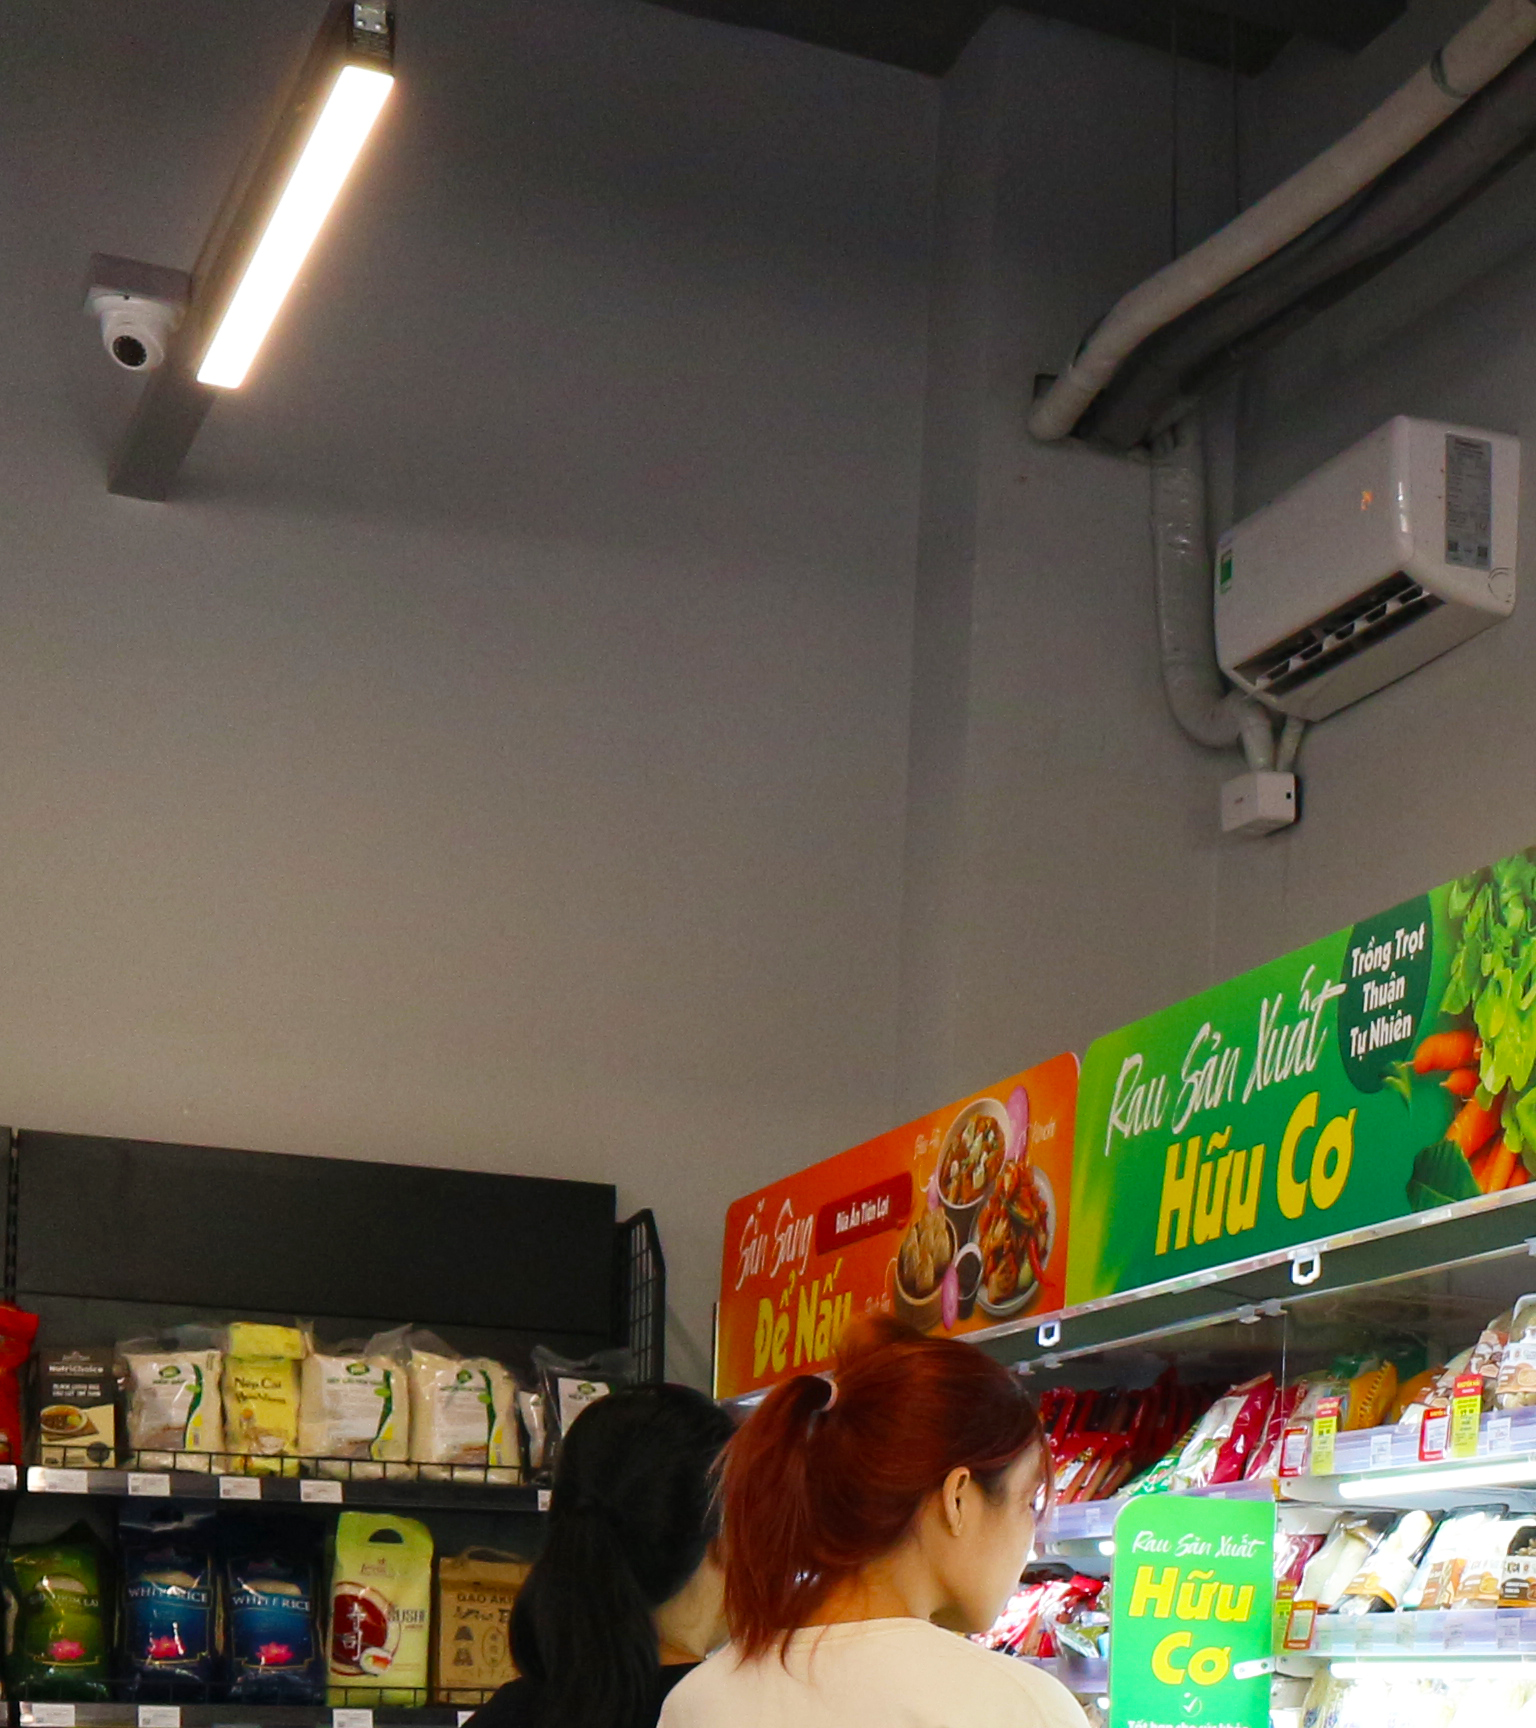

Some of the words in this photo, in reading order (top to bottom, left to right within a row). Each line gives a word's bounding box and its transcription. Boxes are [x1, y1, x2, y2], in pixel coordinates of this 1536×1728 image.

[1351, 936, 1391, 978] Trồng
[1395, 921, 1425, 961] Trọt
[1362, 973, 1405, 1013] Thuận
[1104, 1054, 1169, 1157] Rau
[1172, 1021, 1241, 1135] Sản
[1242, 964, 1346, 1105] Xuất
[1350, 1026, 1368, 1061] Tự
[1369, 1010, 1412, 1048] Nhiên
[1154, 1125, 1266, 1256] Hữu
[1276, 1090, 1358, 1220] Cơ
[1132, 1530, 1170, 1554] Rau
[1174, 1534, 1213, 1558] Sản
[1215, 1534, 1266, 1559] Xuất
[1128, 1564, 1256, 1623] Hữu
[1151, 1631, 1232, 1686] Cơ
